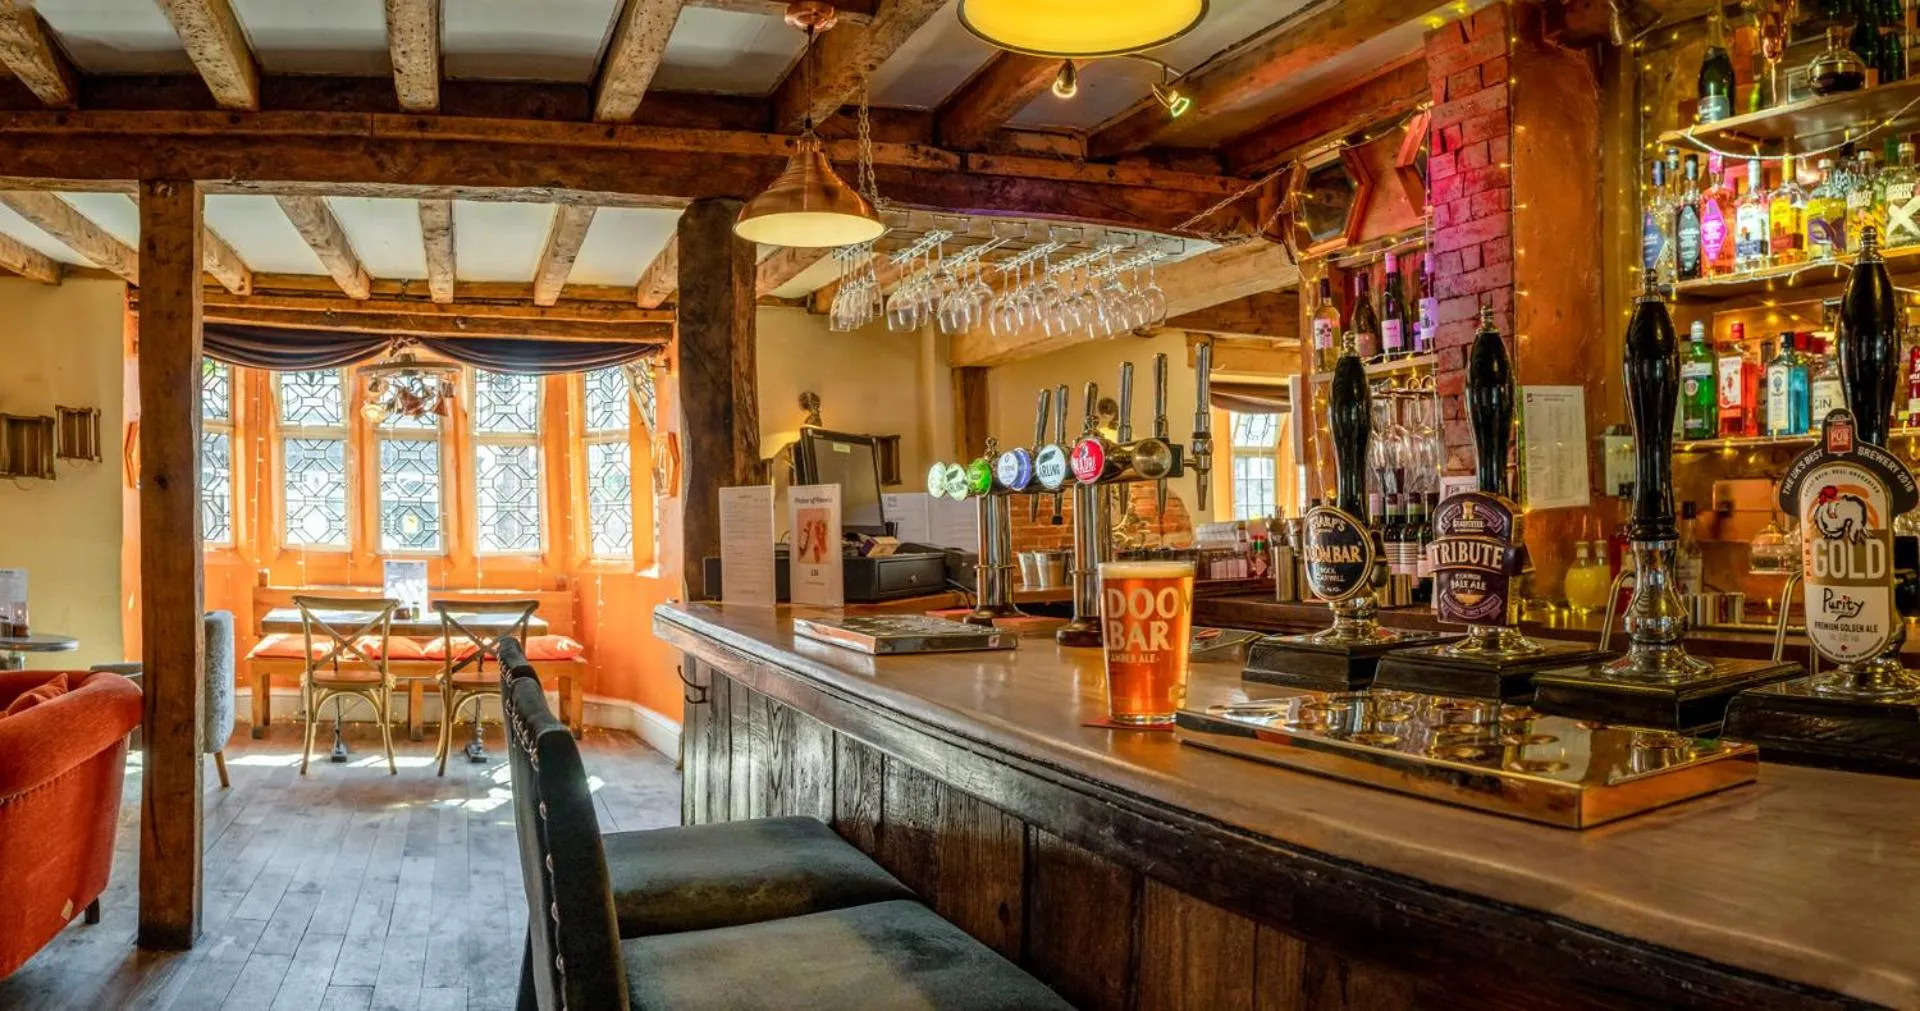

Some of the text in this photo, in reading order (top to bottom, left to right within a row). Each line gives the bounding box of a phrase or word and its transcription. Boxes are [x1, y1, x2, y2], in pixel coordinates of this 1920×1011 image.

[1040, 463, 1060, 478] ARLING
[1782, 477, 1794, 495] THE
[1791, 462, 1806, 476] UK'S
[1804, 448, 1824, 465] BEST
[1857, 446, 1900, 474] BREWERY
[1308, 514, 1346, 532] HARP'S
[1332, 545, 1362, 562] BAR
[1432, 541, 1505, 570] TRIBUTE
[1812, 538, 1886, 579] GOLD
[1451, 580, 1487, 591] PALE ALE
[1823, 587, 1865, 621] Purity
[1109, 620, 1173, 652] BAR
[1814, 621, 1879, 633] PREMIUM GOLDEN ALE
[1139, 653, 1156, 663] ALE
